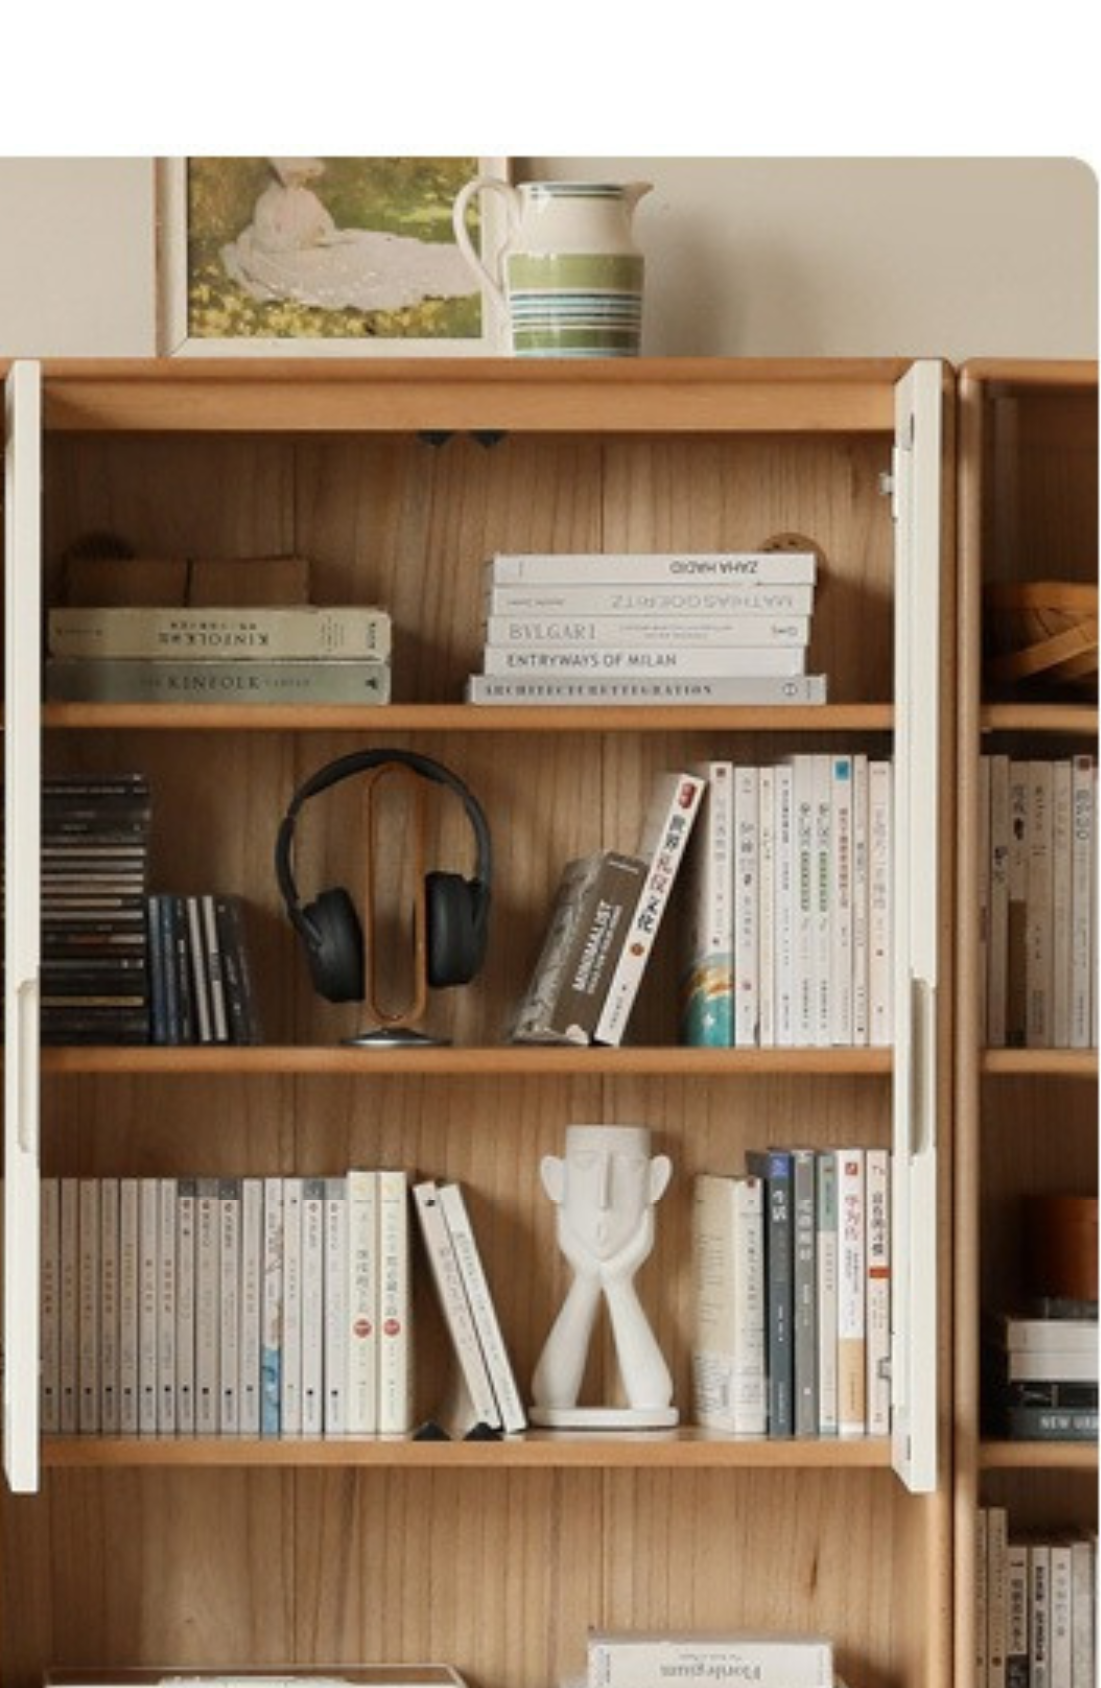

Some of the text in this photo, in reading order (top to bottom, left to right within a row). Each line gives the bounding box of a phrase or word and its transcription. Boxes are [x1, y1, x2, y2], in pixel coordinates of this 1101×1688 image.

[720, 561, 758, 574] ZAHA
[507, 655, 677, 667] ENTRYWAYS OF MILAN
